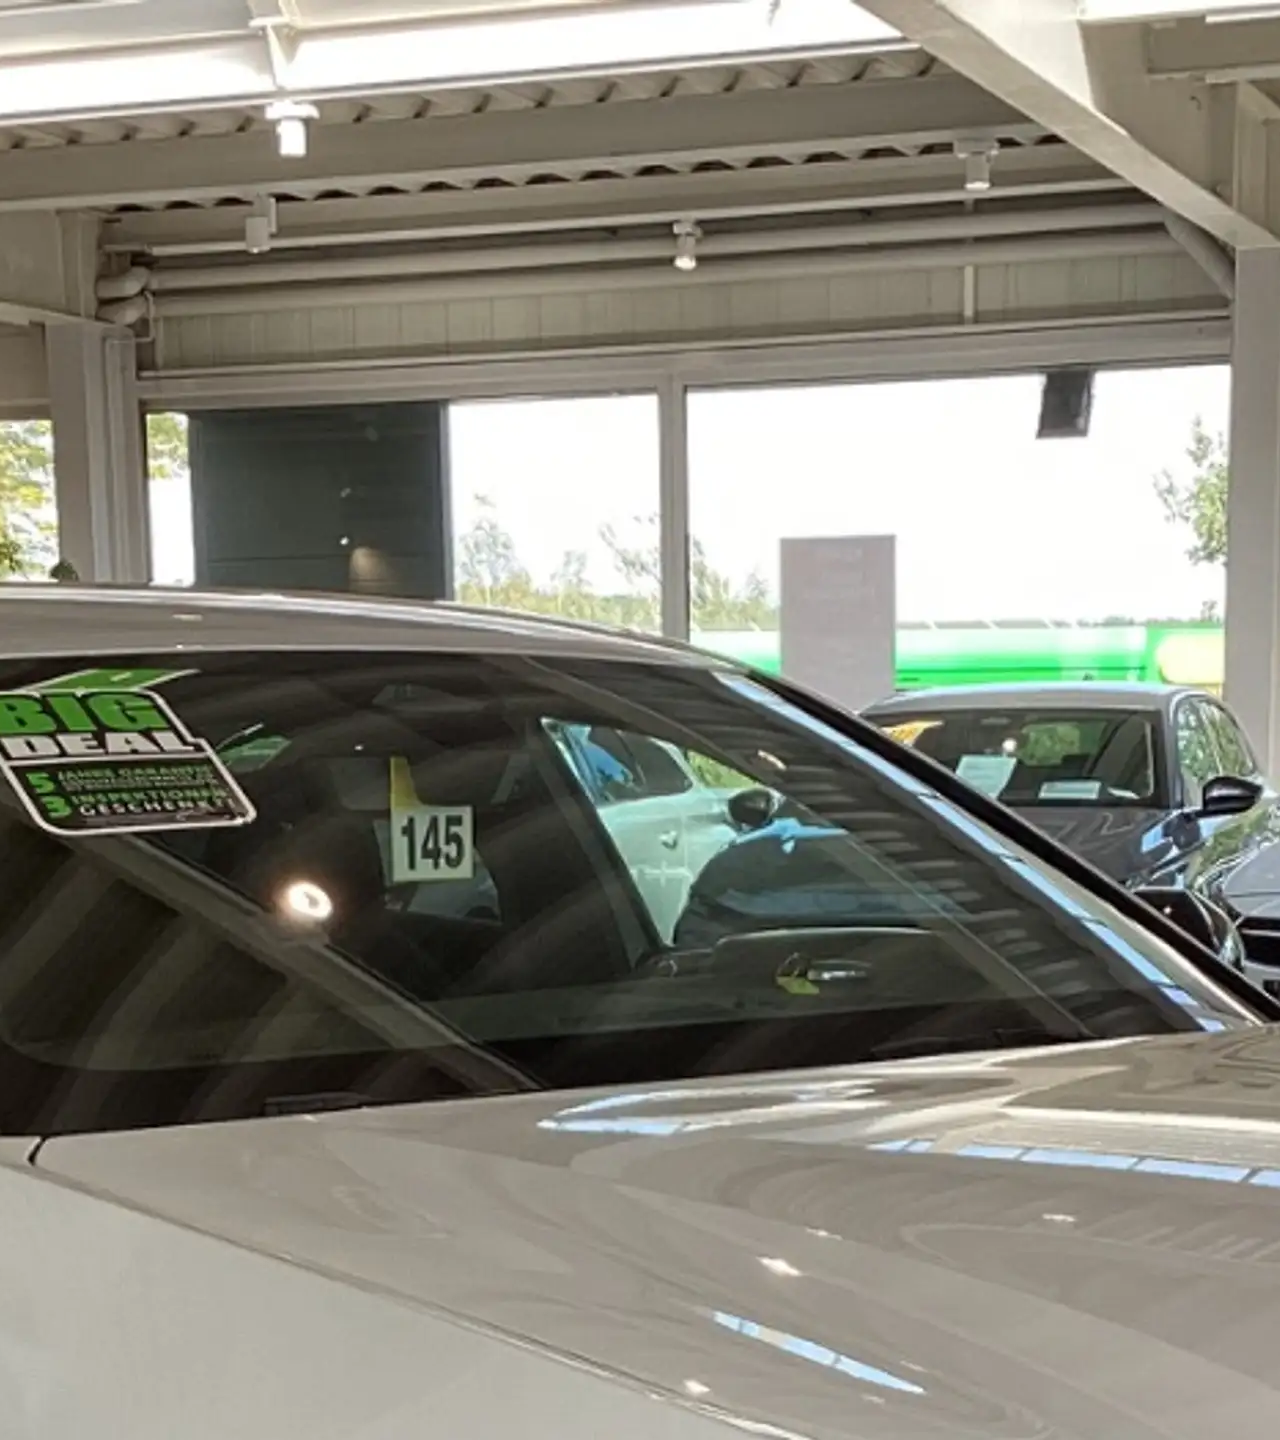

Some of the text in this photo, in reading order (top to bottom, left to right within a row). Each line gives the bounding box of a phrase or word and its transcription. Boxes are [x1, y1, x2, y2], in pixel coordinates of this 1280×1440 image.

[0, 731, 195, 758] DEAL
[26, 772, 55, 793] 5
[41, 796, 72, 818] 3
[401, 814, 466, 870] 145
